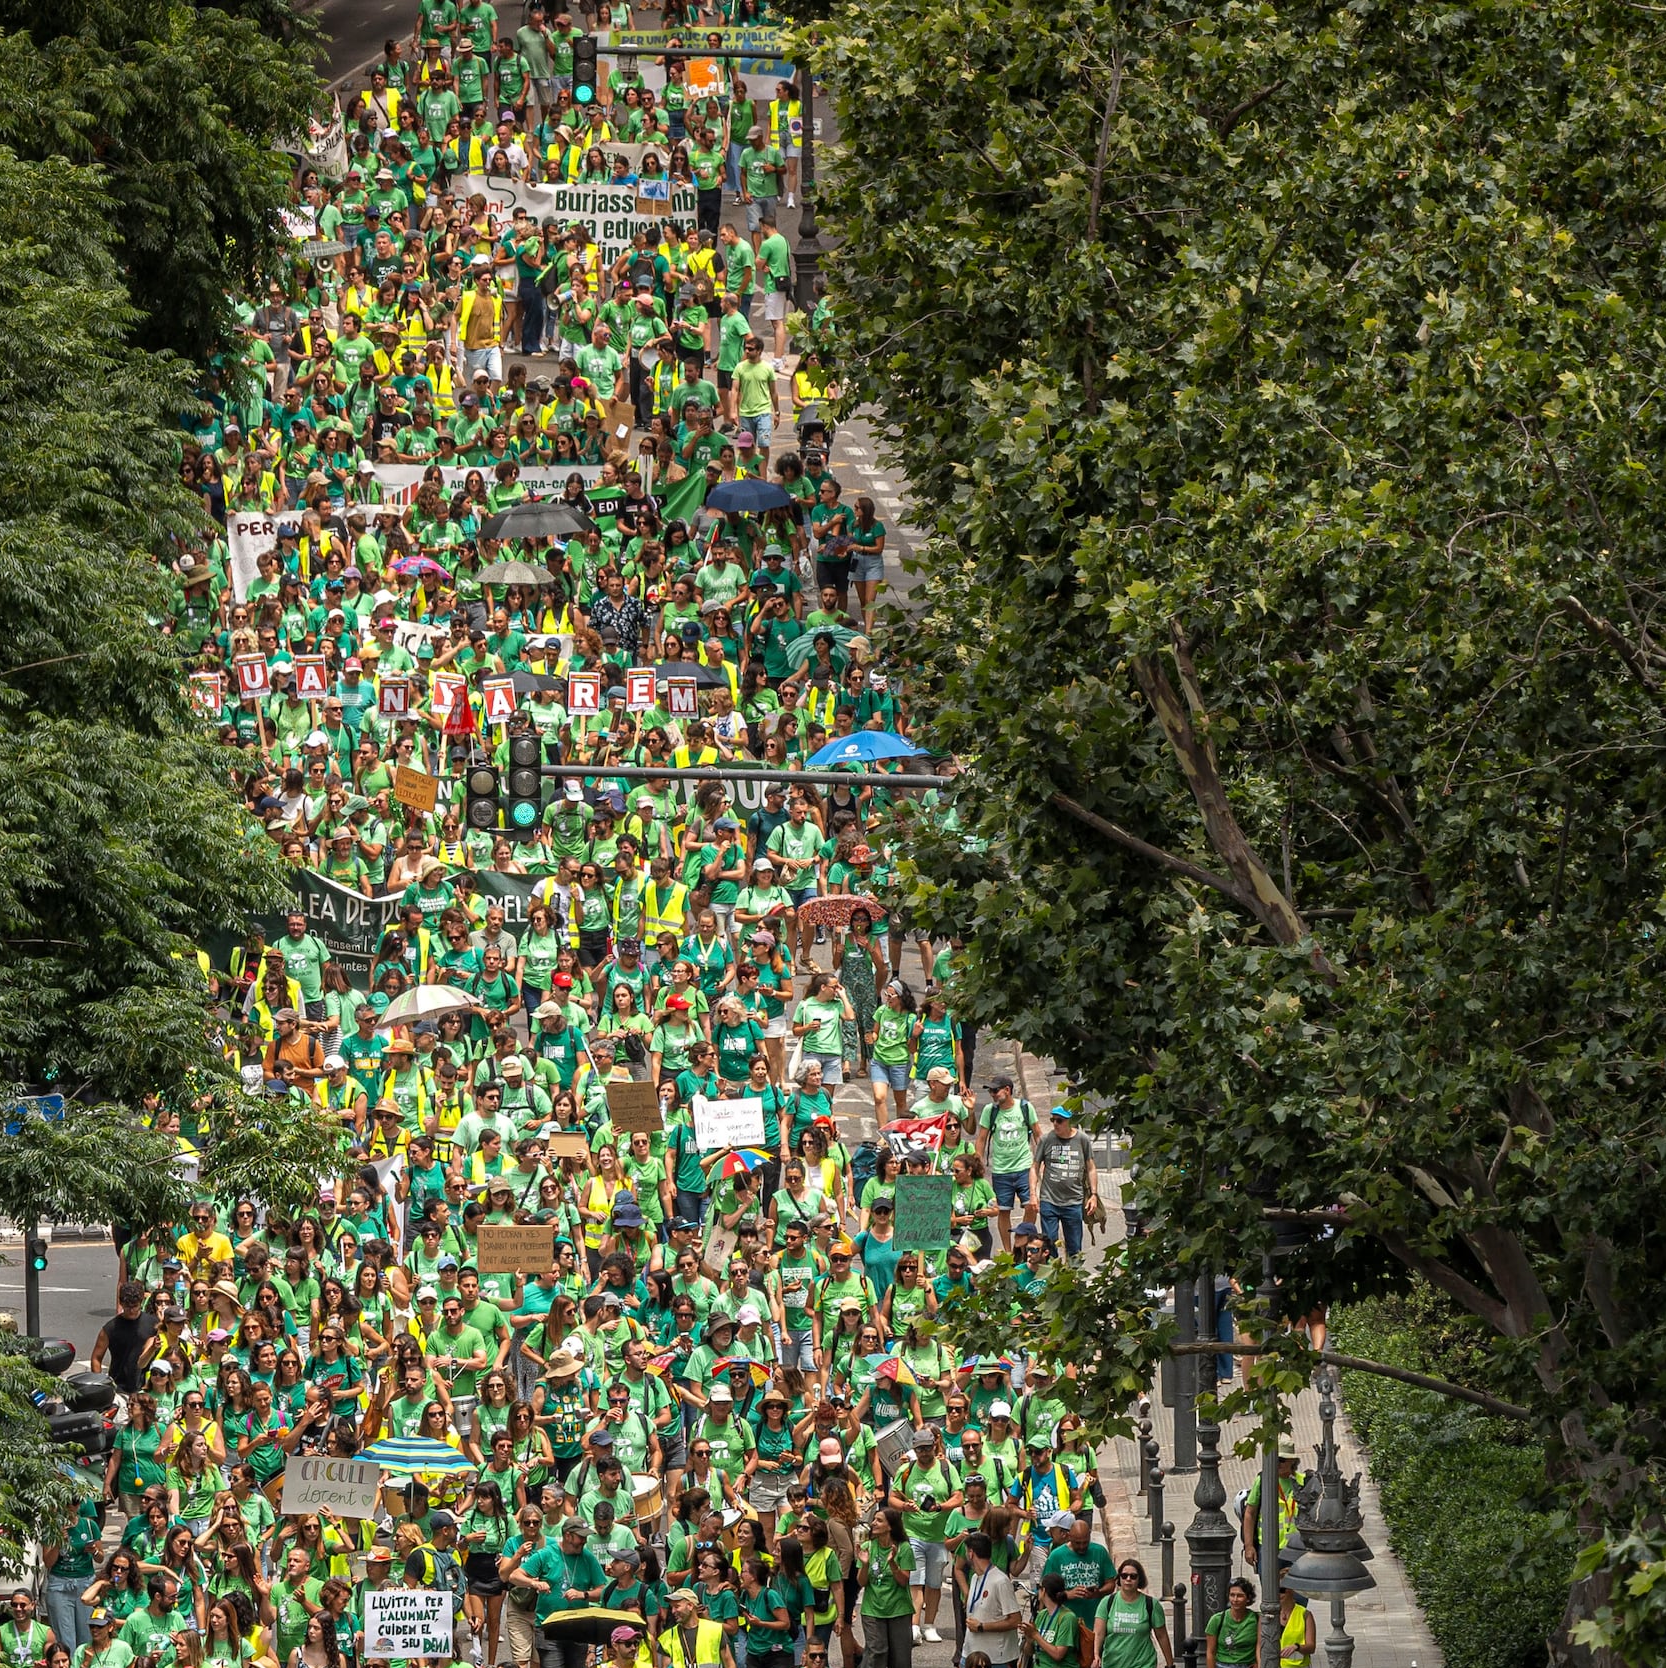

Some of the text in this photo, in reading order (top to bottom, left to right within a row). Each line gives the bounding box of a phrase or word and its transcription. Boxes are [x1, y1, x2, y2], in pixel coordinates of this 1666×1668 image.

[236, 521, 275, 537] PER
[243, 665, 264, 689] U
[302, 666, 323, 690] A
[383, 688, 405, 712] N
[491, 689, 511, 716] A
[574, 682, 596, 707] R
[633, 679, 652, 704] E
[671, 687, 694, 712] M
[301, 1460, 369, 1484] ORGULL
[298, 1484, 357, 1506] docent
[425, 1595, 444, 1607] PER
[421, 1623, 432, 1635] EL
[401, 1638, 421, 1649] SEU
